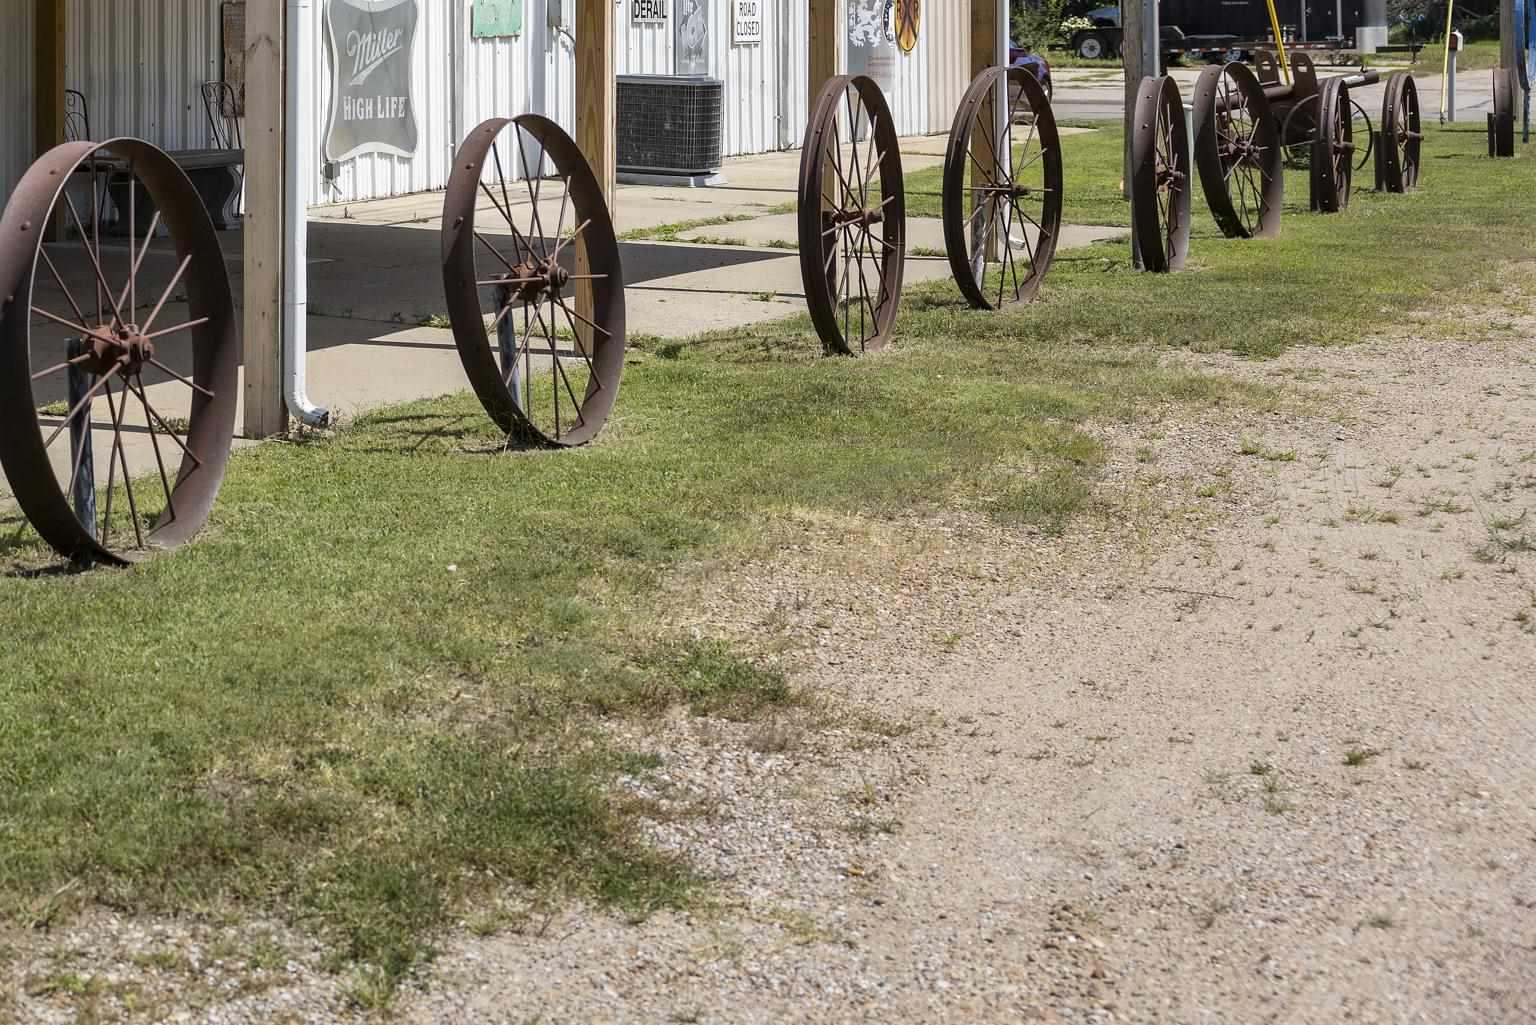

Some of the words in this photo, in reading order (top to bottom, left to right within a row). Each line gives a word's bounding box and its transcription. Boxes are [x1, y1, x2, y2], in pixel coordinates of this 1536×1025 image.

[634, 0, 668, 19] DERAIL
[739, 1, 756, 17] ROAD
[736, 21, 759, 36] CLOSED
[346, 27, 403, 78] Miller
[343, 95, 373, 121] HIGH
[376, 95, 406, 120] LIFE
